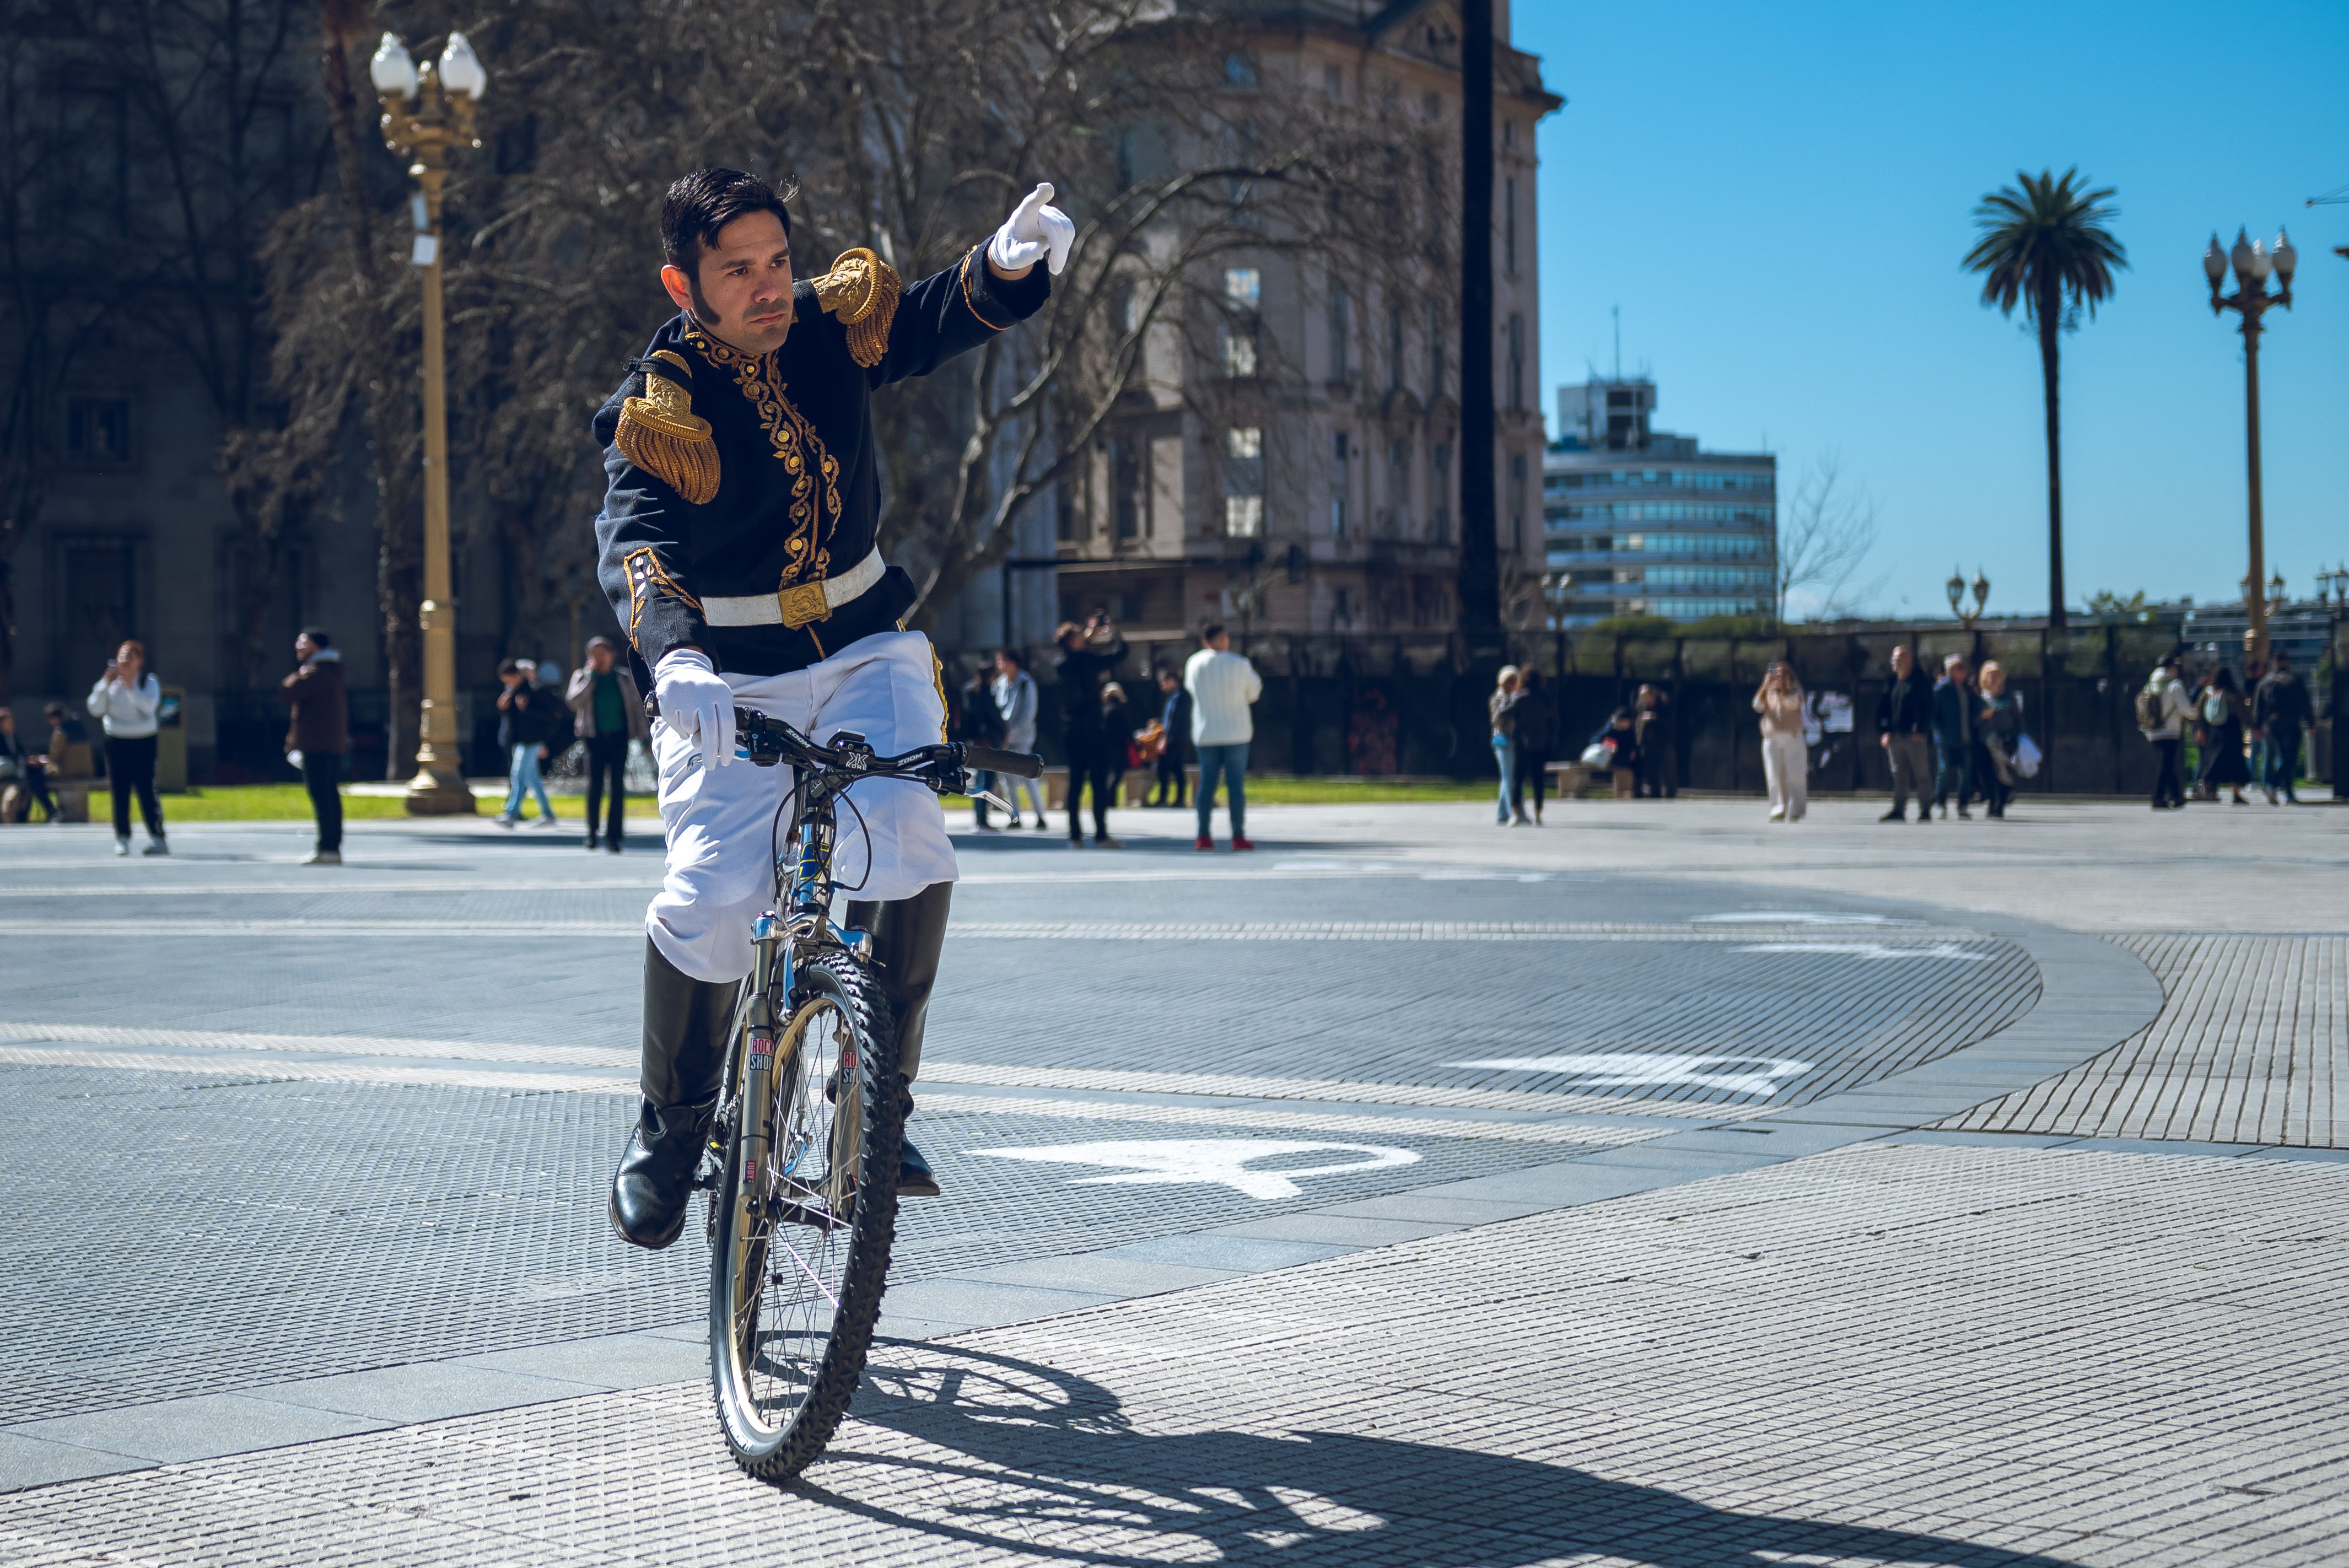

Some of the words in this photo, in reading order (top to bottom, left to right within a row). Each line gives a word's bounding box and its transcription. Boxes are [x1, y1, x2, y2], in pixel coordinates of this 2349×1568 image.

[785, 728, 812, 748] ZOOM
[897, 752, 923, 767] ZOOM
[752, 1039, 774, 1055] ROCK
